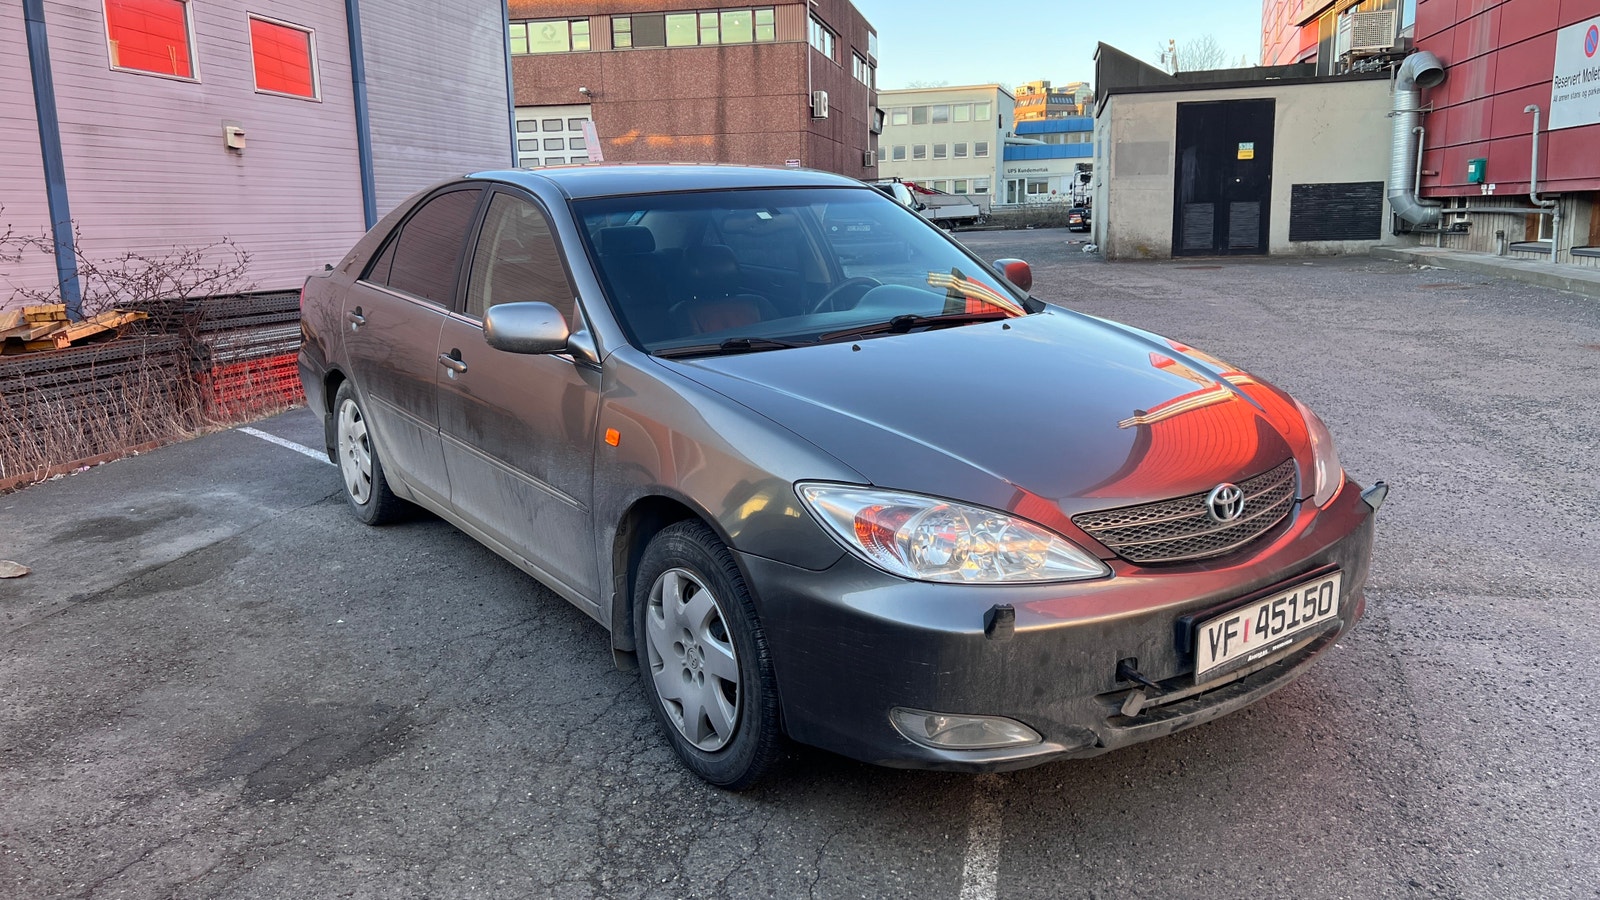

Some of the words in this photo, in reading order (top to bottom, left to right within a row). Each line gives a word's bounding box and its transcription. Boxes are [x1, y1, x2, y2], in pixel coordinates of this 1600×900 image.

[1554, 70, 1580, 89] Reservert
[1209, 616, 1240, 662] VF
[1255, 580, 1334, 640] 45150
